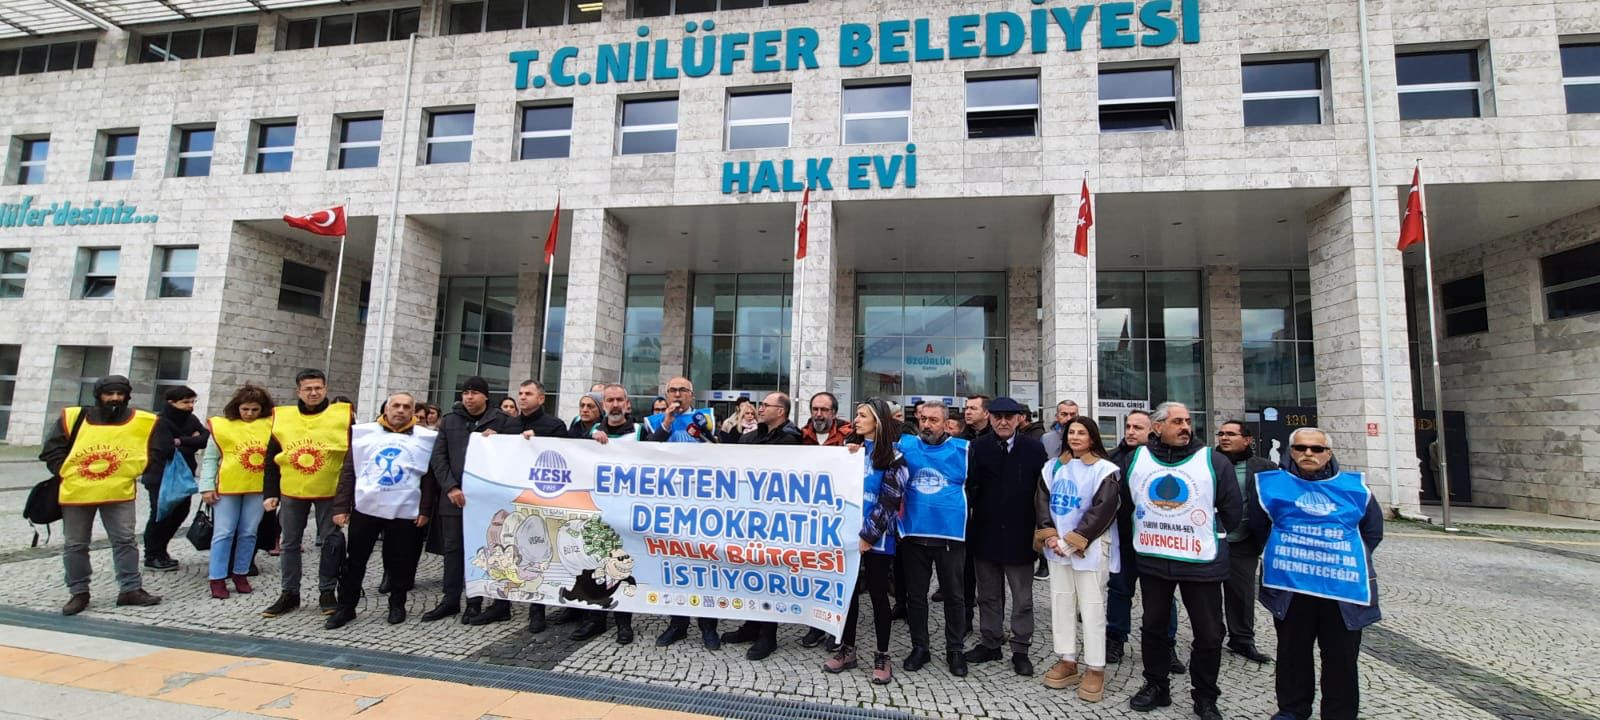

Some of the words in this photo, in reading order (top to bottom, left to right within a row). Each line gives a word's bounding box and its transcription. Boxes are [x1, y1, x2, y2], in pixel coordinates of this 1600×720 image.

[722, 157, 833, 194] HALK
[848, 143, 917, 189] EVİ
[906, 355, 952, 366] ÖZGÜRLÜK
[925, 343, 934, 353] A
[528, 468, 573, 483] KESK
[596, 465, 737, 499] EMEKTEN
[746, 470, 842, 511] YANA,
[632, 505, 842, 547] DEMOKRATİK
[1292, 525, 1322, 537] KRİZİ
[646, 537, 721, 561] HALK
[726, 542, 844, 573] BÜTÇESİ
[1140, 531, 1189, 552] GÜVENCELİ
[1191, 536, 1202, 556] İŞ
[1275, 545, 1340, 565] FATURASINI
[1342, 555, 1358, 568] DA
[664, 562, 844, 607] İSTİYORUZ!
